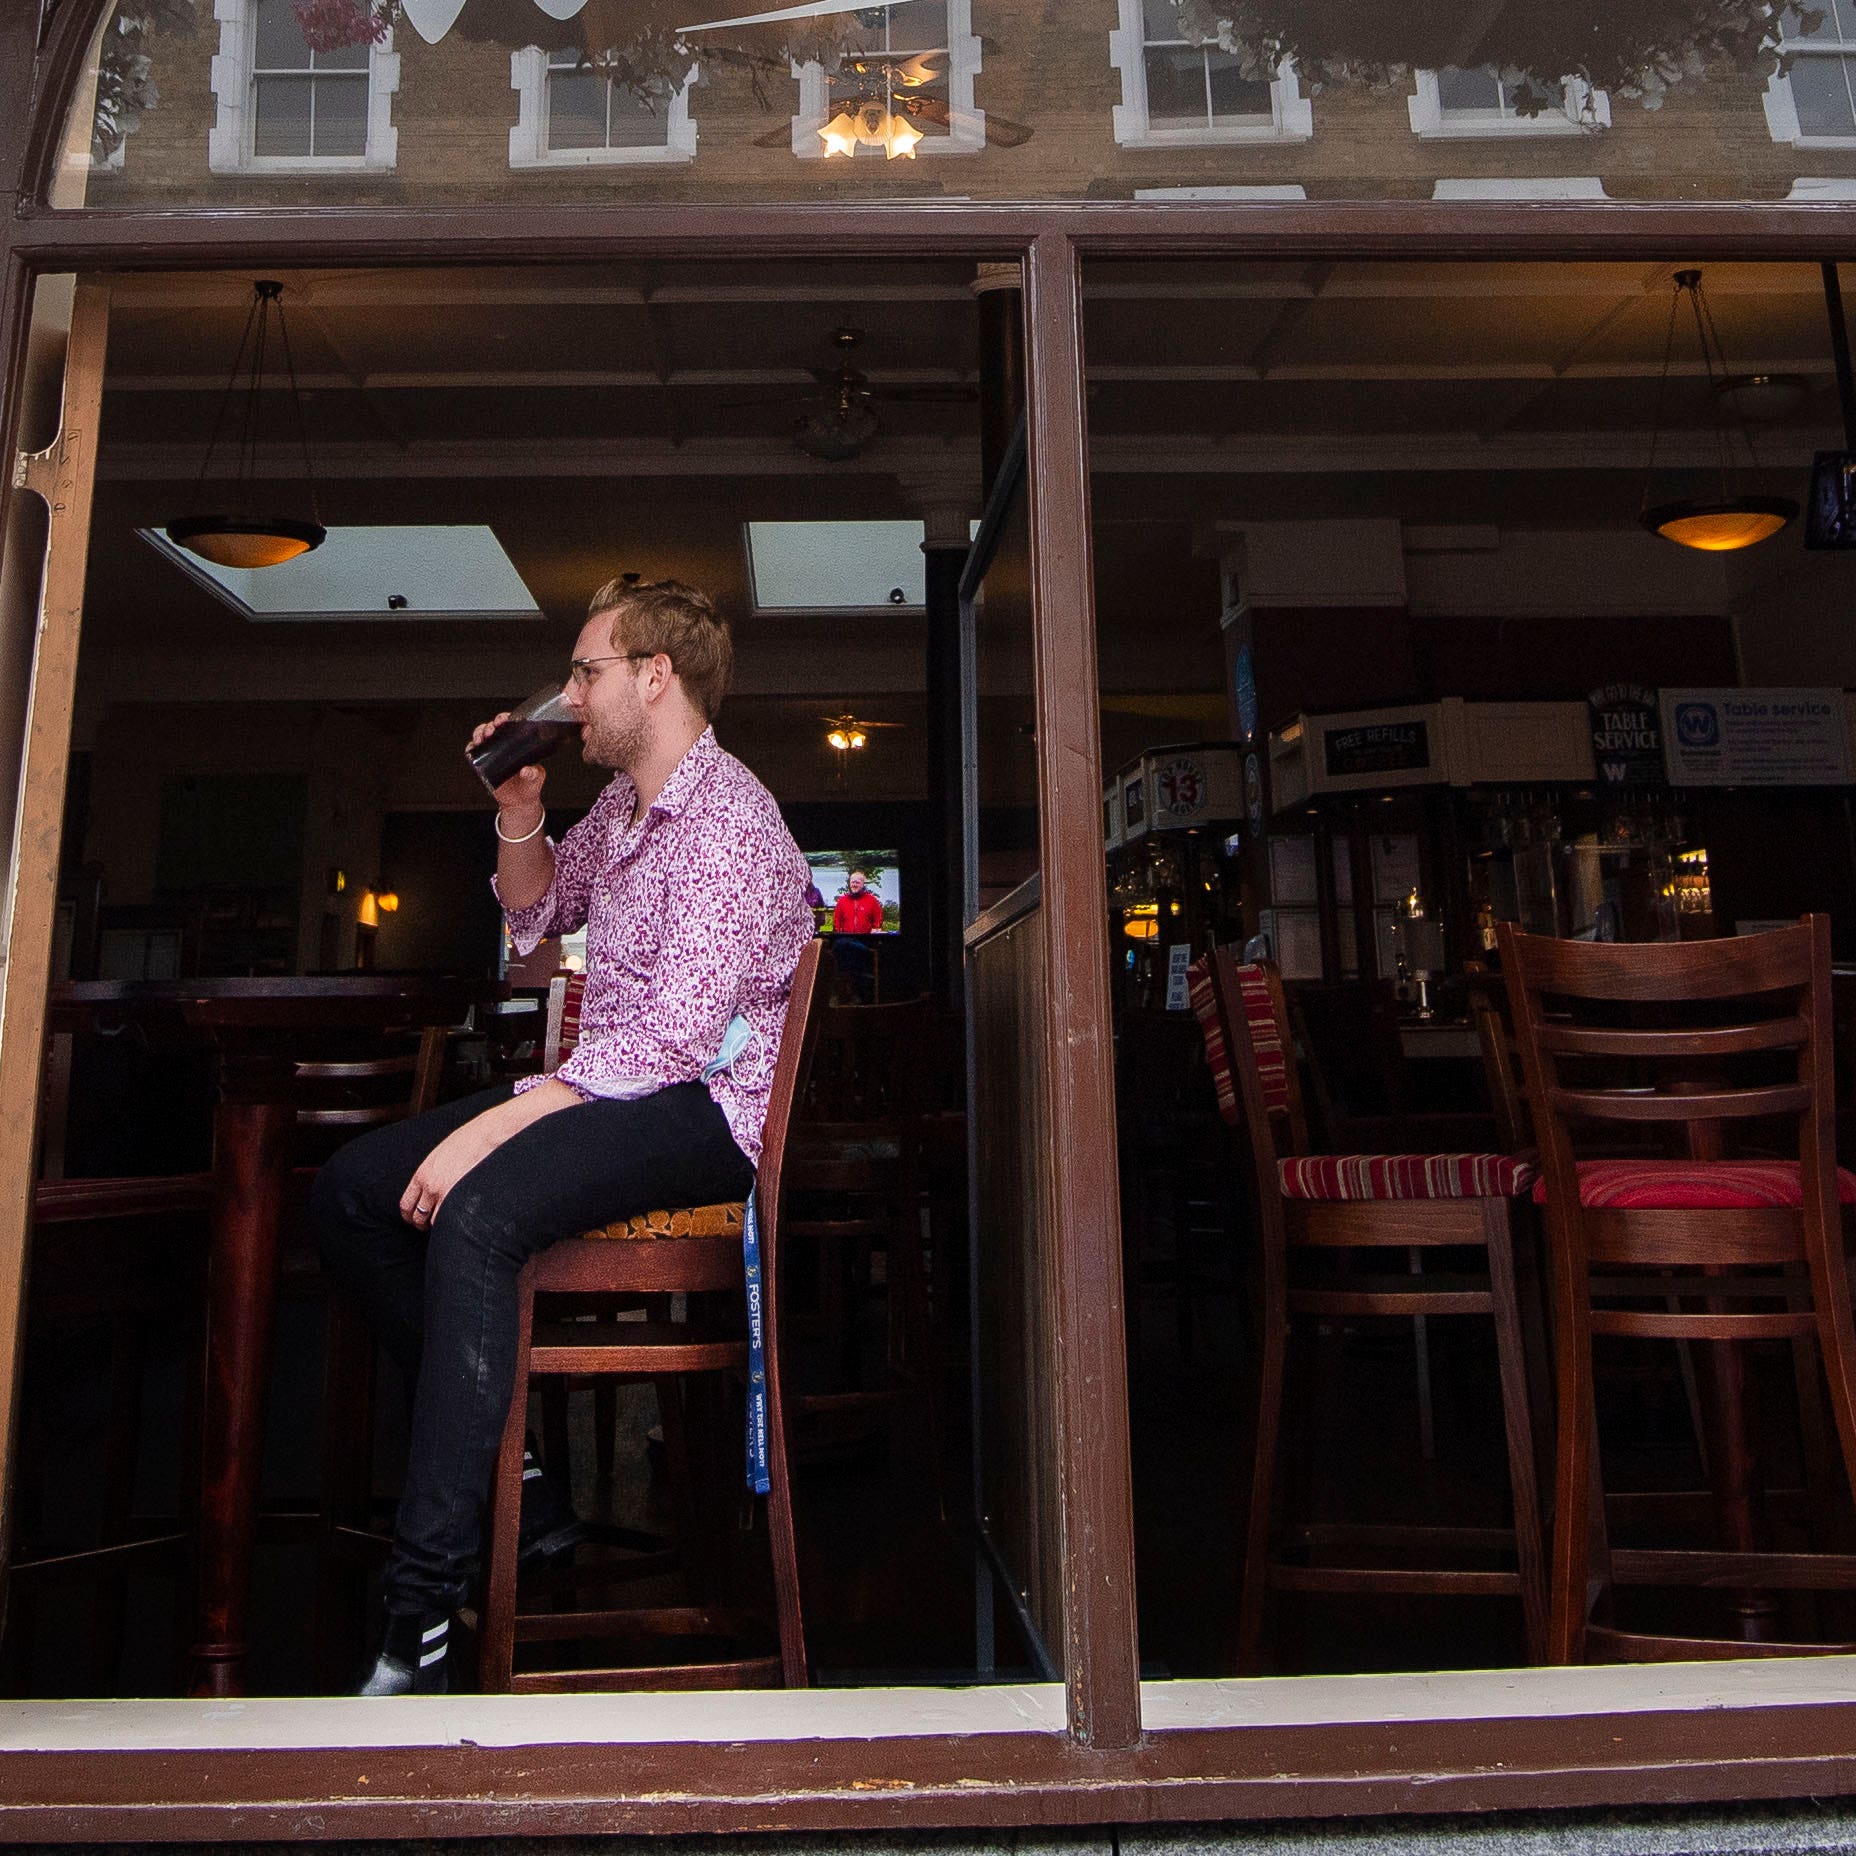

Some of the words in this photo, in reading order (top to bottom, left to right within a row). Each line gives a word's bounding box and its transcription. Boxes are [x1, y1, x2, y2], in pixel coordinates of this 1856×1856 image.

[1723, 702, 1768, 717] Table
[1772, 701, 1832, 717] service
[1600, 711, 1649, 731] TABLE
[1593, 731, 1659, 751] SERVICE
[748, 1282, 762, 1349] FOSTER'S
